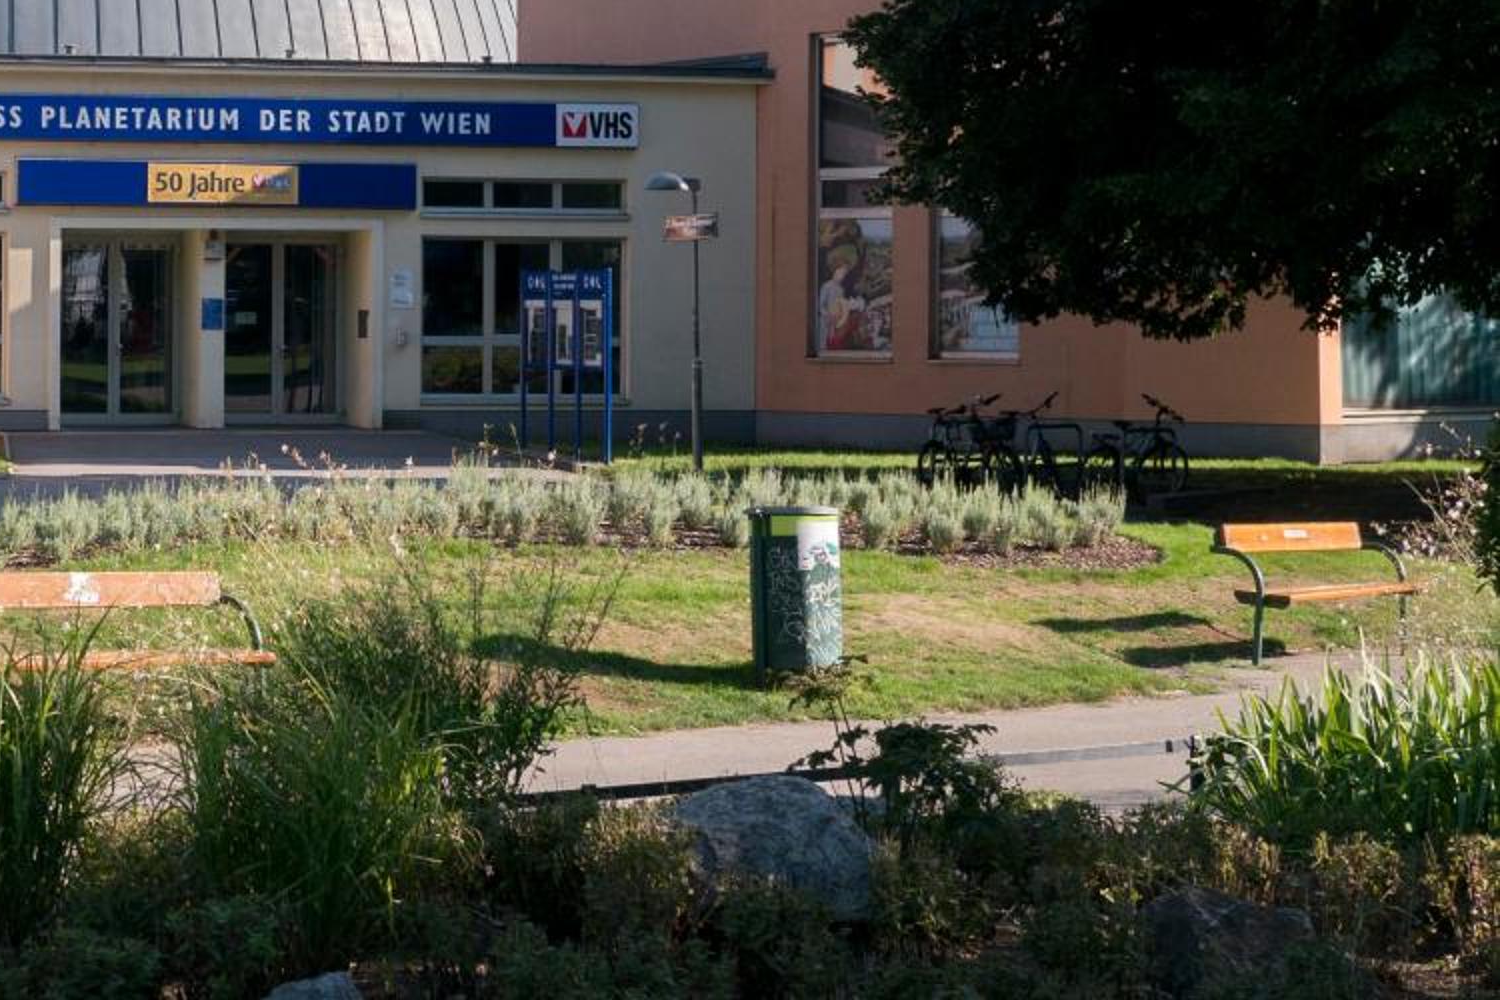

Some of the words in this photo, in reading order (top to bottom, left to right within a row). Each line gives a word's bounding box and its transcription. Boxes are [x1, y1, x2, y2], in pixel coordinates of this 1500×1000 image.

[41, 104, 240, 131] PLANETARIUM
[259, 109, 311, 132] DER
[328, 110, 406, 133] STADT
[420, 111, 492, 136] WIEN
[589, 110, 633, 139] VHS
[155, 172, 183, 193] 50
[188, 171, 245, 198] Jahre
